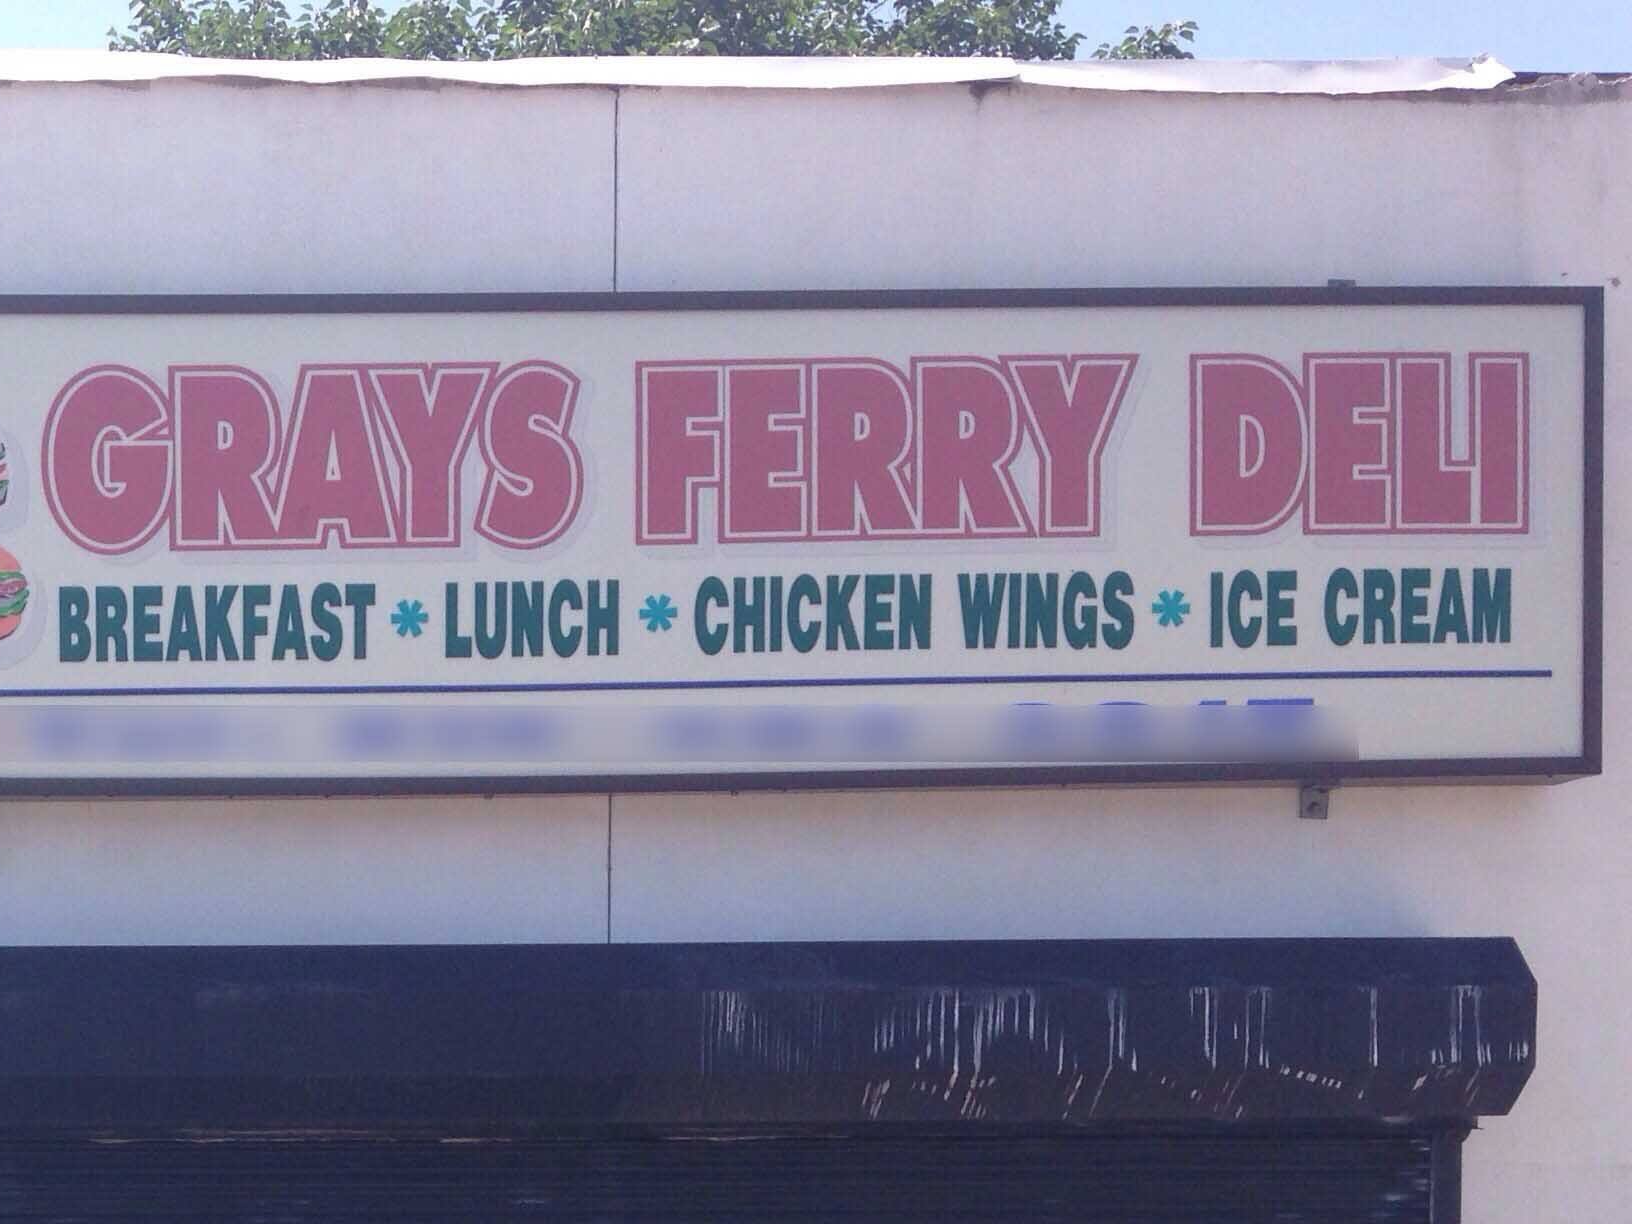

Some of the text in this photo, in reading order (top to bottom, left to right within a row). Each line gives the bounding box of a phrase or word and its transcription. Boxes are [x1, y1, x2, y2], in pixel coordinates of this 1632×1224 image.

[42, 352, 1531, 554] GRAYS FERRY DELI
[58, 566, 1513, 663] BREAKFAST LUNCH CHICKEN WINGS ICE CREAM
